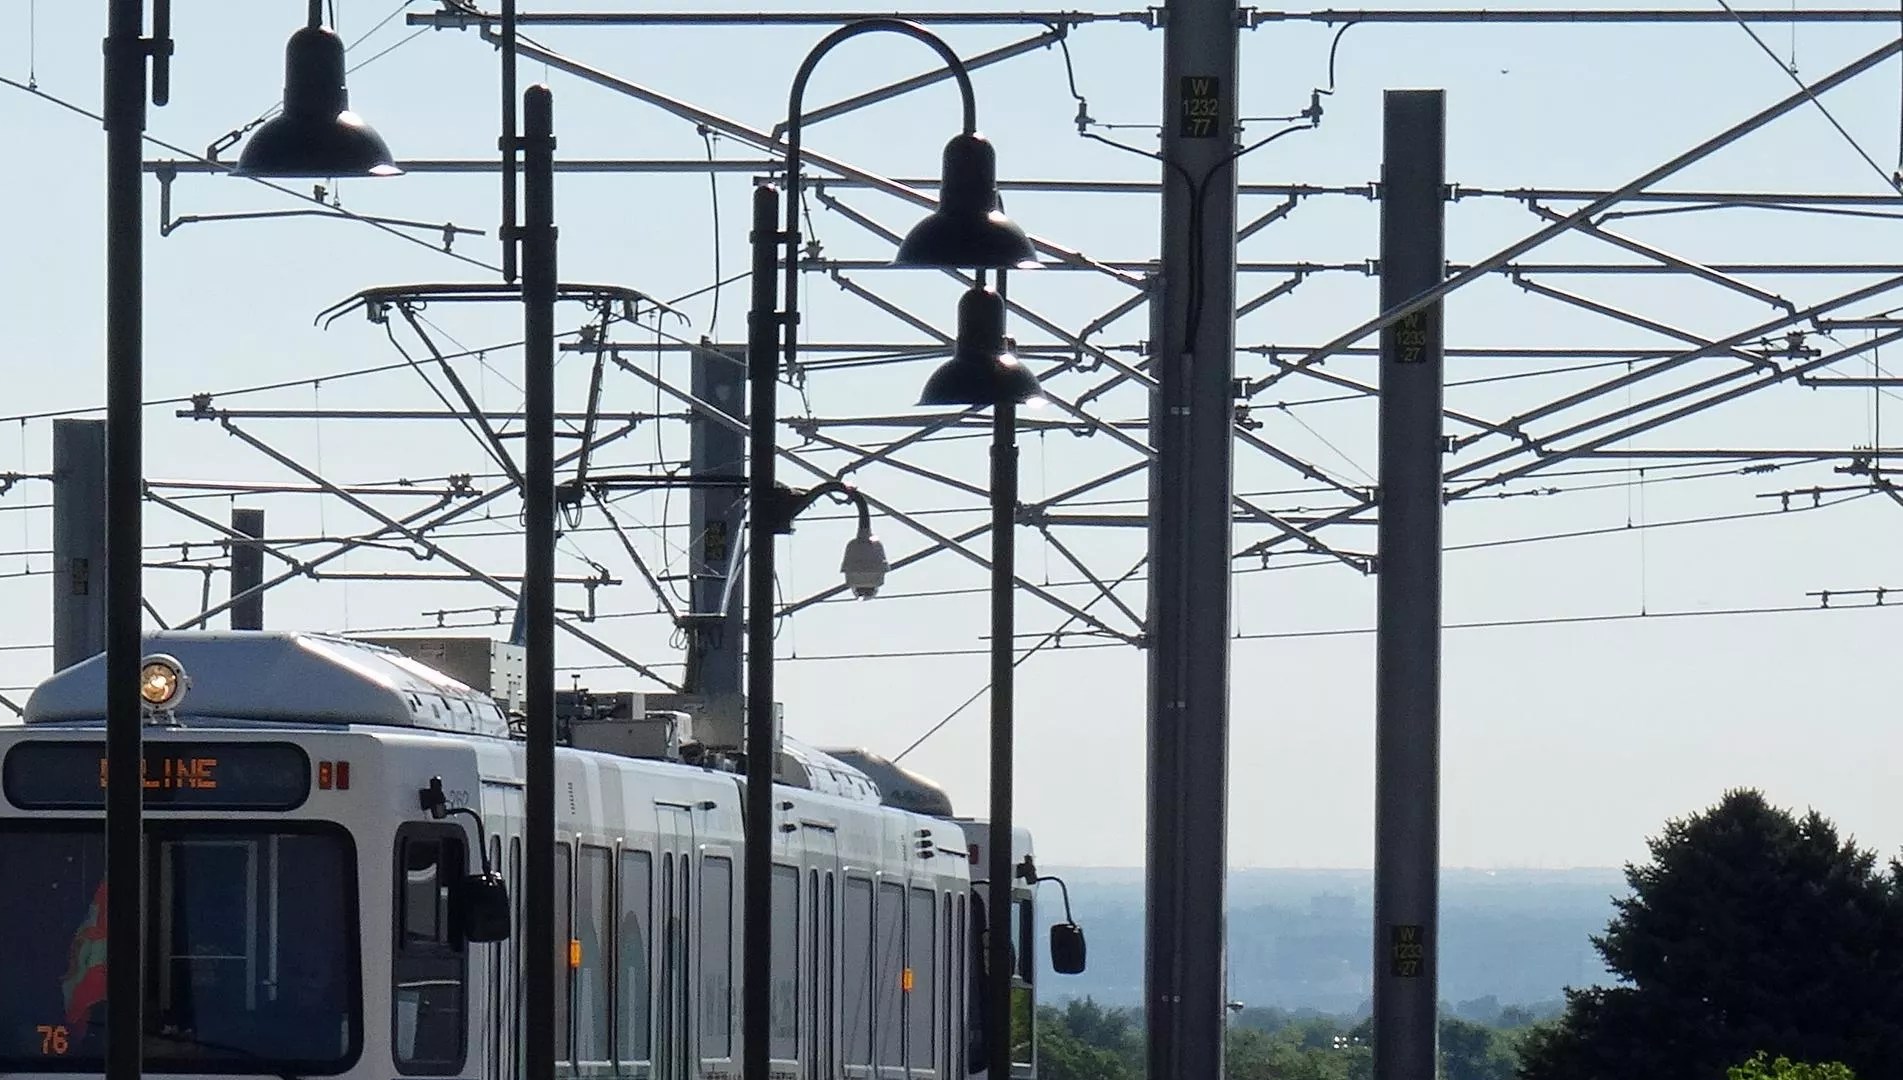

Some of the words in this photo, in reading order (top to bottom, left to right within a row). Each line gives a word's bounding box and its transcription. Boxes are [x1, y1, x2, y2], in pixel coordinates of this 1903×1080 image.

[1192, 78, 1209, 96] W
[1184, 98, 1218, 116] 1232
[142, 758, 217, 788] LINE
[36, 1025, 69, 1054] 76
